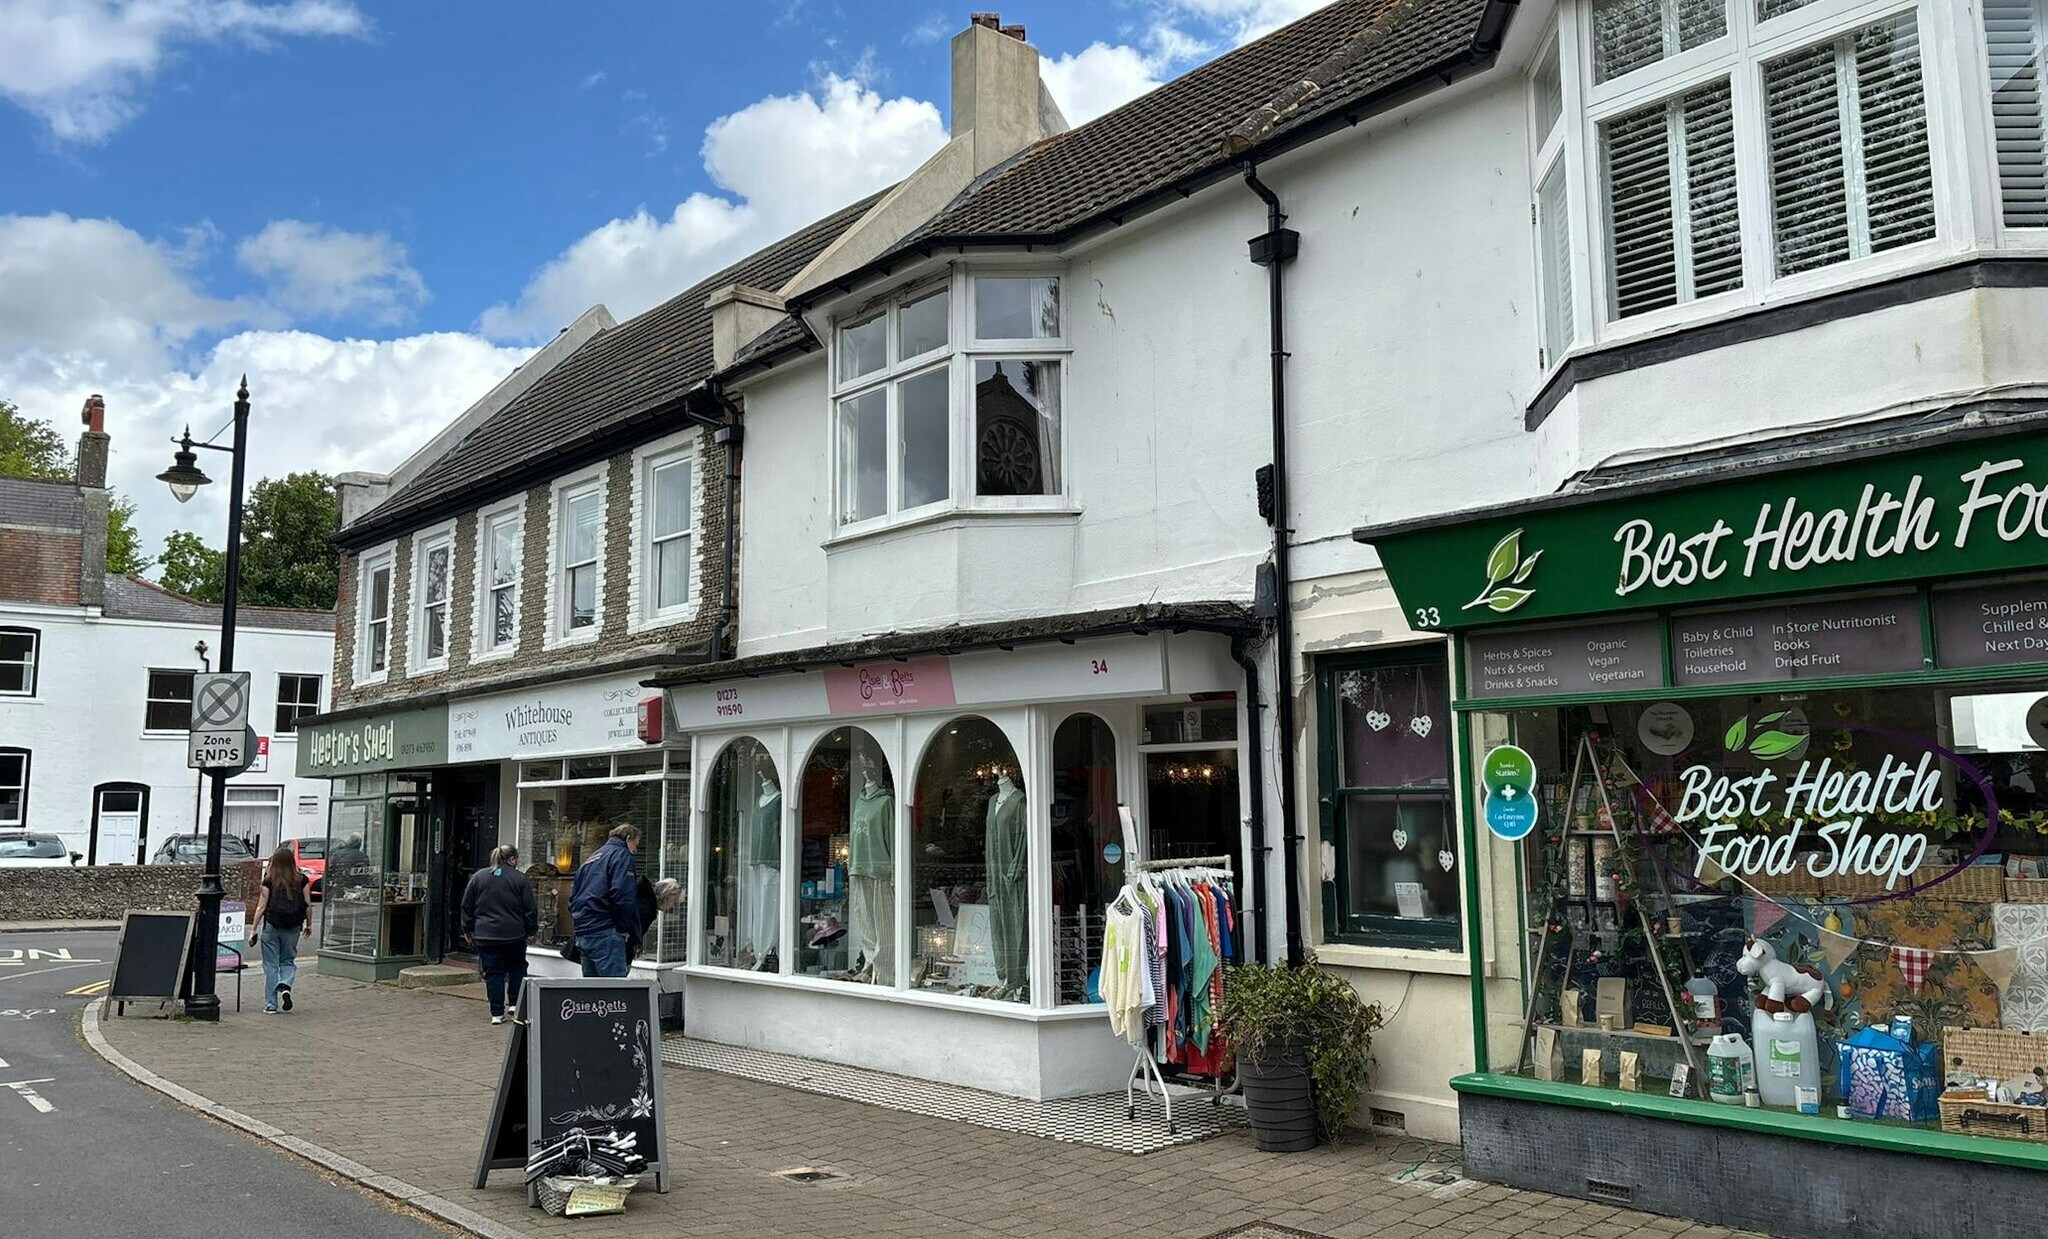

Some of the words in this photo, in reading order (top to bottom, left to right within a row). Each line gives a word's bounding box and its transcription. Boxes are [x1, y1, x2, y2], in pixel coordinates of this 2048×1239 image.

[1613, 518, 1734, 597] Best
[1742, 475, 1940, 578] Health
[1416, 606, 1441, 628] 33
[1772, 624, 1785, 635] In
[1786, 621, 1819, 635] Store
[1822, 614, 1897, 631] Nutritionist
[1982, 617, 2035, 634] Chilled
[1682, 631, 1710, 645] Baby
[1712, 630, 1721, 641] &
[1723, 626, 1754, 640] Child
[1587, 638, 1628, 654] Organic
[1683, 645, 1735, 660] Toiletries
[1773, 638, 1811, 652] Books
[1985, 640, 2020, 653] Next
[1483, 649, 1512, 661] Herbs
[1513, 649, 1520, 660] &
[1522, 647, 1553, 661] Spices
[1587, 655, 1620, 669] Vegan
[1775, 654, 1809, 669] Dried
[1811, 652, 1841, 667] Fruit
[1091, 660, 1108, 674] 34
[1484, 664, 1507, 676] Nuts
[1508, 664, 1515, 674] &
[1516, 662, 1545, 674] Seeds
[1685, 659, 1747, 675] Household
[860, 668, 881, 700] Elsie
[882, 673, 891, 690] &
[890, 668, 914, 697] Betts
[1484, 678, 1515, 691] Drinks
[1516, 678, 1524, 688] &
[1525, 676, 1559, 688] Snacks
[1588, 668, 1645, 684] Vegetarian
[716, 688, 738, 702] 01273
[505, 700, 573, 732] Whitehouse
[603, 705, 638, 718] COLLECTABLE
[716, 702, 743, 717] 911590
[618, 717, 625, 727] &
[204, 735, 232, 746] Zone
[518, 729, 558, 747] ANTIQUES
[608, 728, 635, 740] JEWELLERY
[195, 748, 239, 762] ENDS
[310, 728, 360, 768] Hector's
[1674, 764, 1778, 824] Best
[1783, 750, 1943, 819] Health
[1693, 817, 1803, 879] Food
[1806, 815, 1928, 891] Shop
[561, 999, 592, 1020] Elsie
[592, 1002, 598, 1013] &
